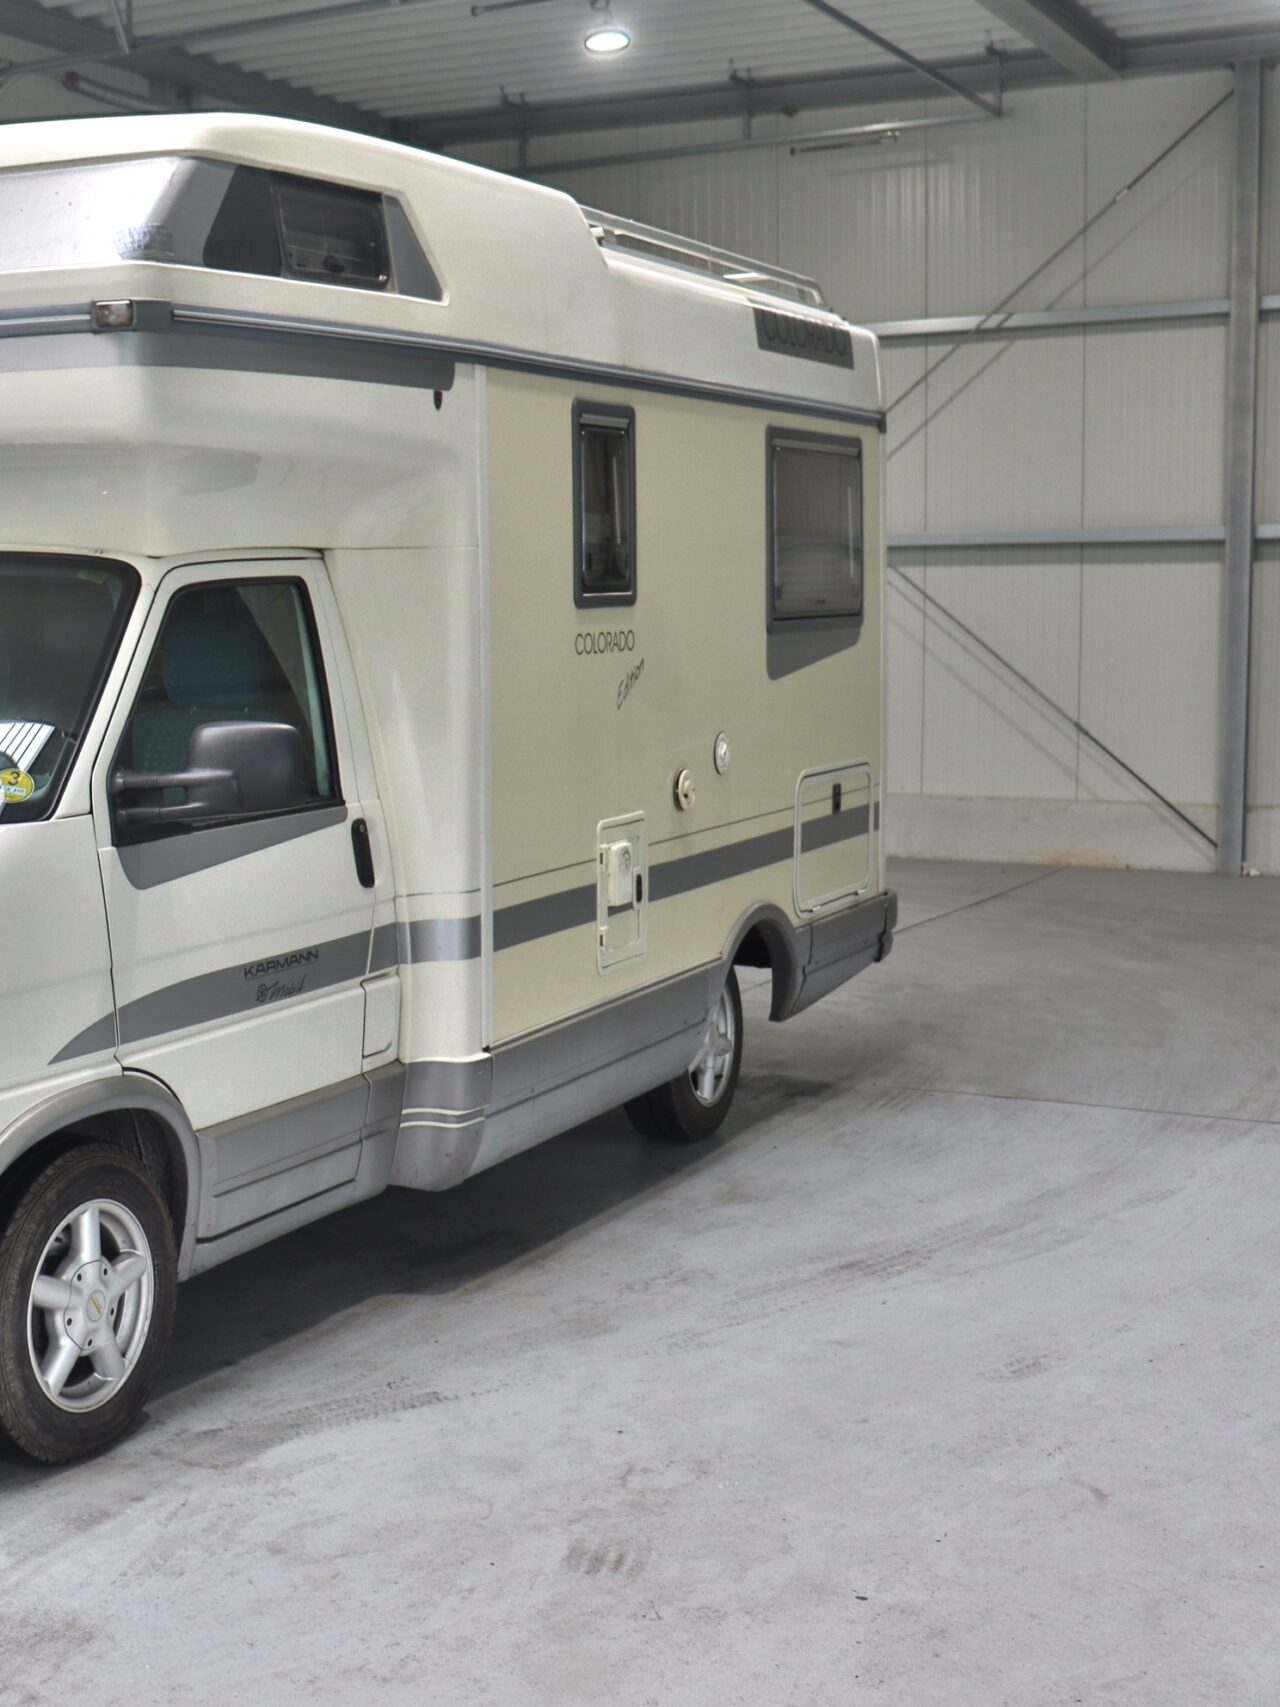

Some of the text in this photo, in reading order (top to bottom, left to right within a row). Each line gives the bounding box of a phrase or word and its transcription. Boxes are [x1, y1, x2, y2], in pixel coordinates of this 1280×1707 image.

[575, 630, 635, 655] COLORADO
[7, 771, 20, 786] 3
[244, 949, 319, 979] KARMANN
